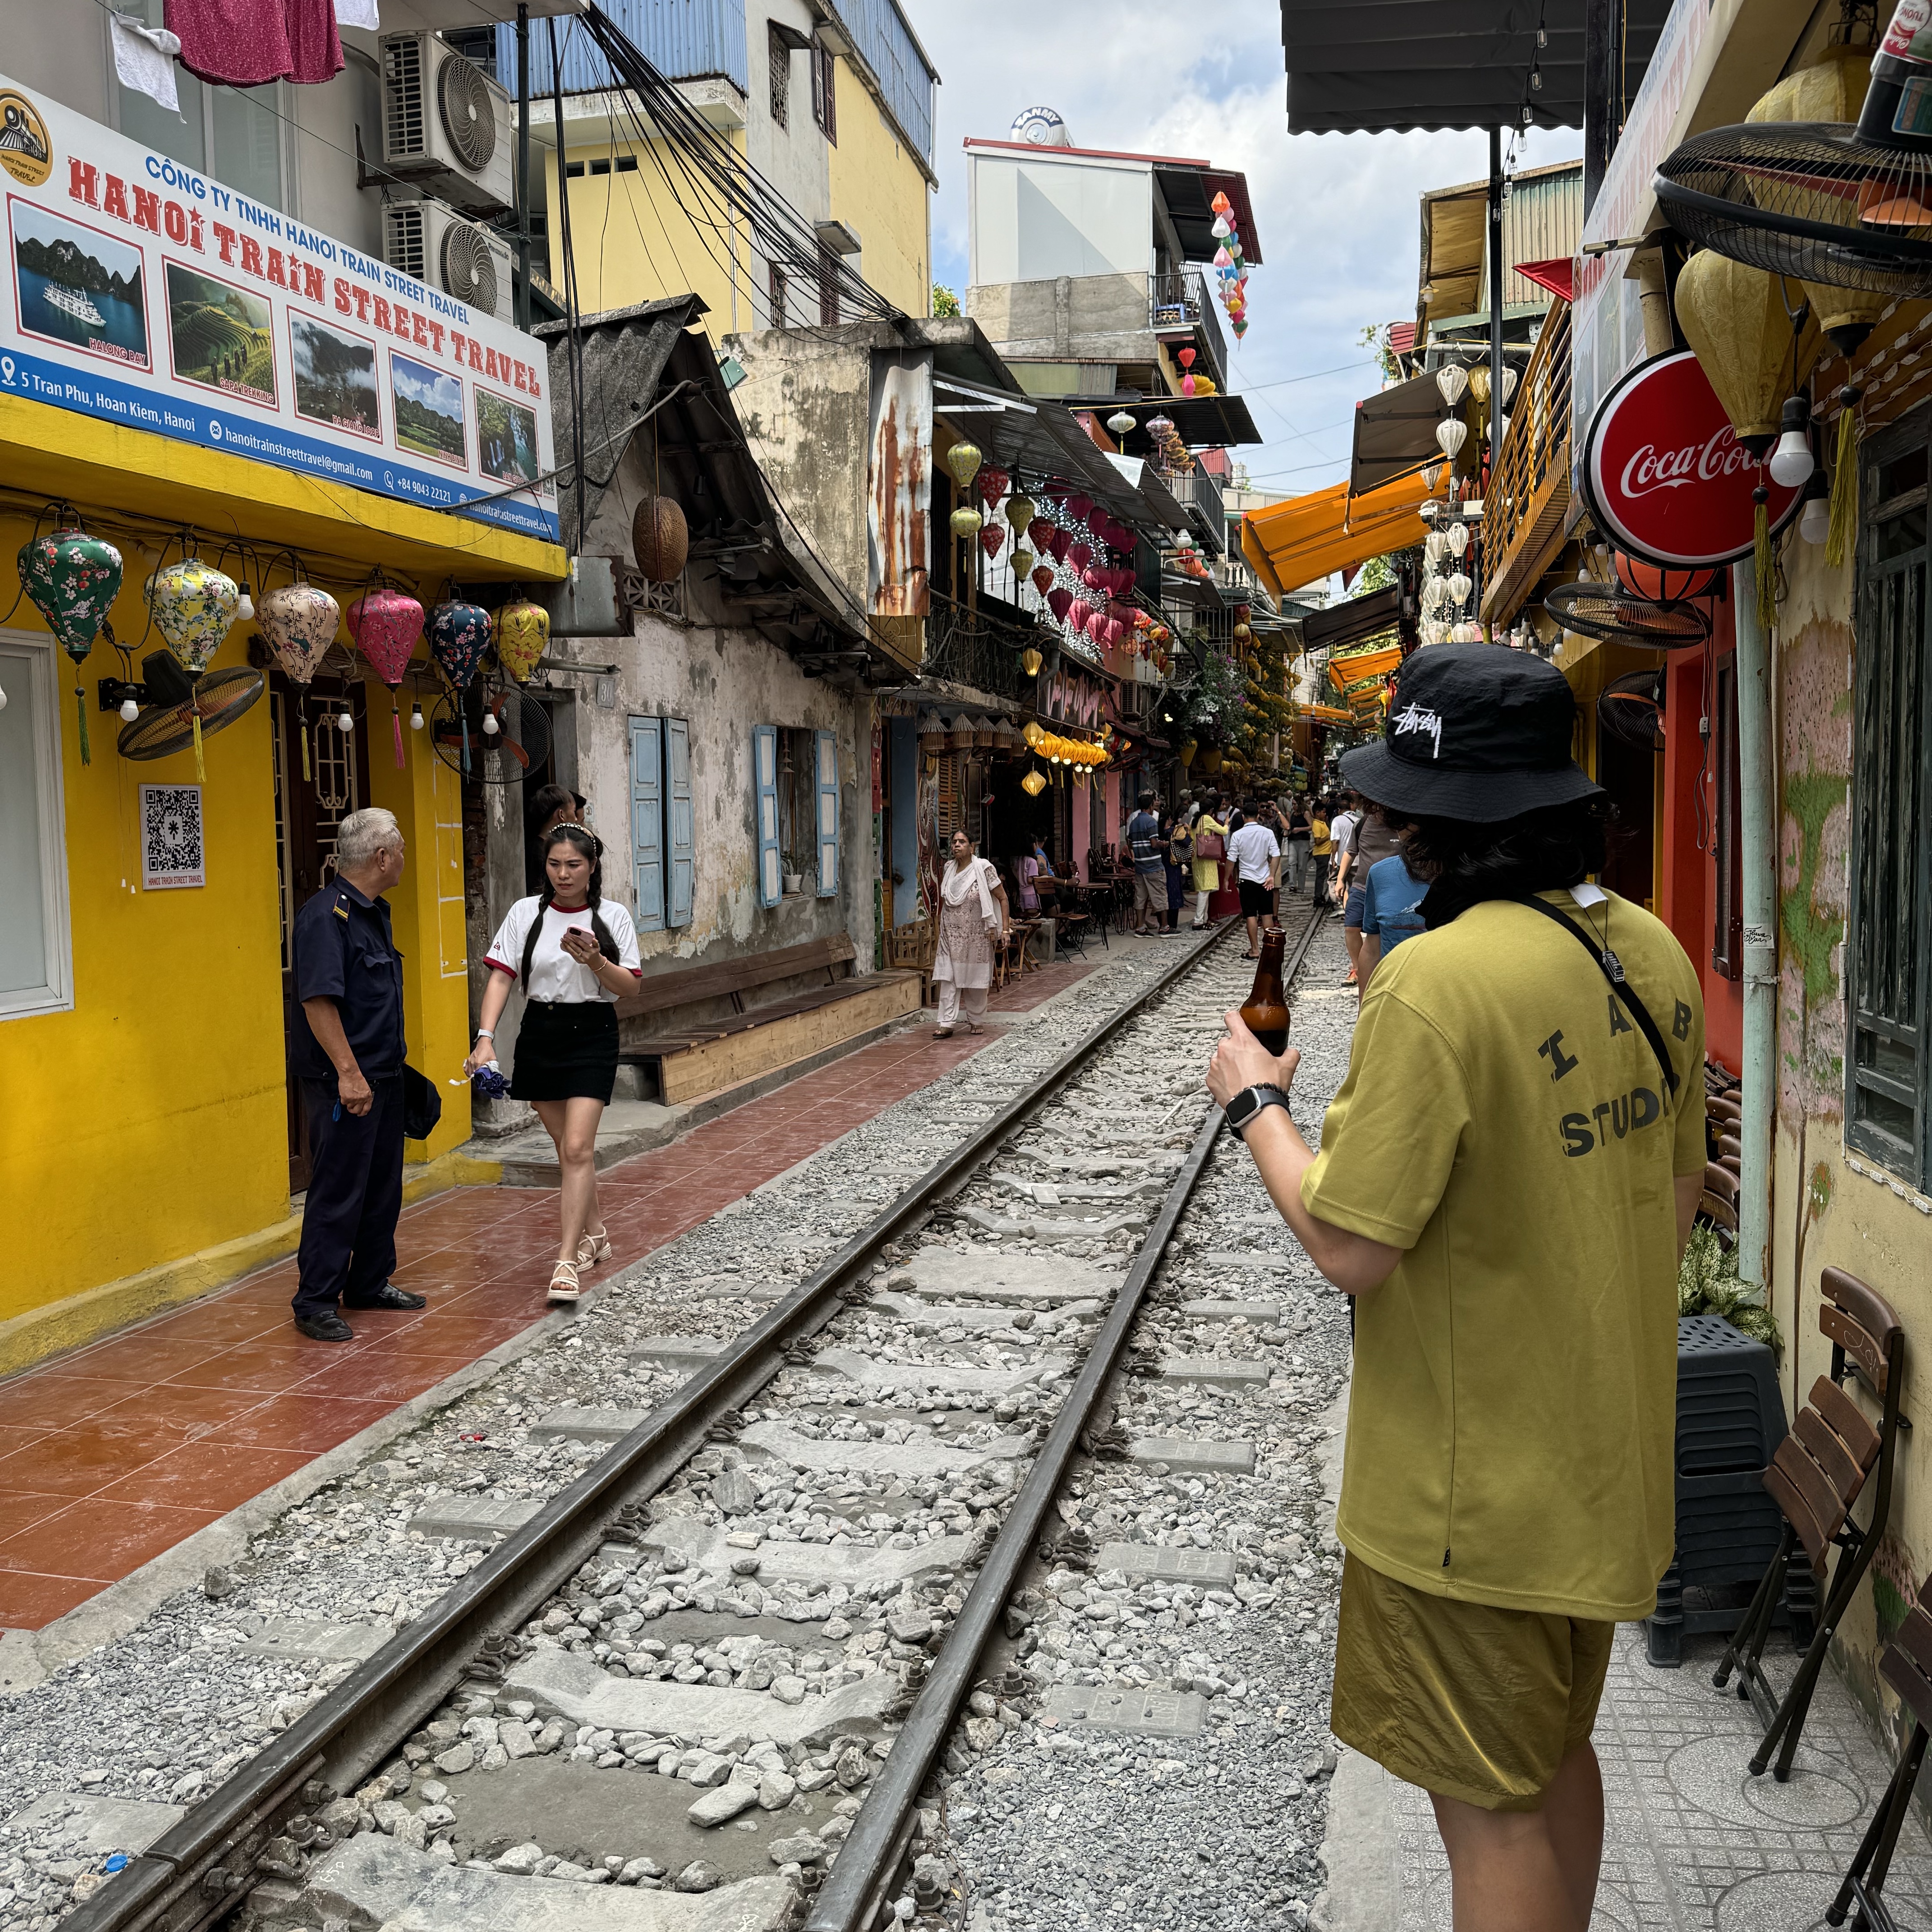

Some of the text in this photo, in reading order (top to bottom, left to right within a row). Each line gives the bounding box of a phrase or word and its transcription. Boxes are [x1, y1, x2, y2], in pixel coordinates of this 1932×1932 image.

[1641, 57, 1657, 111] TRAIN
[1658, 8, 1677, 71] STREET
[146, 156, 469, 326] CÔNG TY TNHH HANOI TRAIN STREET TRAVEL
[89, 338, 146, 365] HALONG BAY
[334, 277, 445, 357] STREET
[451, 330, 541, 400] TRAVEL
[21, 372, 195, 432] 5 Tran Phu, Hoan Kiem, Hanoi
[220, 377, 274, 404] SAPA TREKKING
[332, 414, 380, 438] HA GIANG LOOP
[225, 427, 373, 481] hanoitrainstreettravel@gmail.com
[438, 449, 451, 462] NINH
[397, 478, 451, 503] +84 9043 22121
[601, 683, 612, 702] 30
